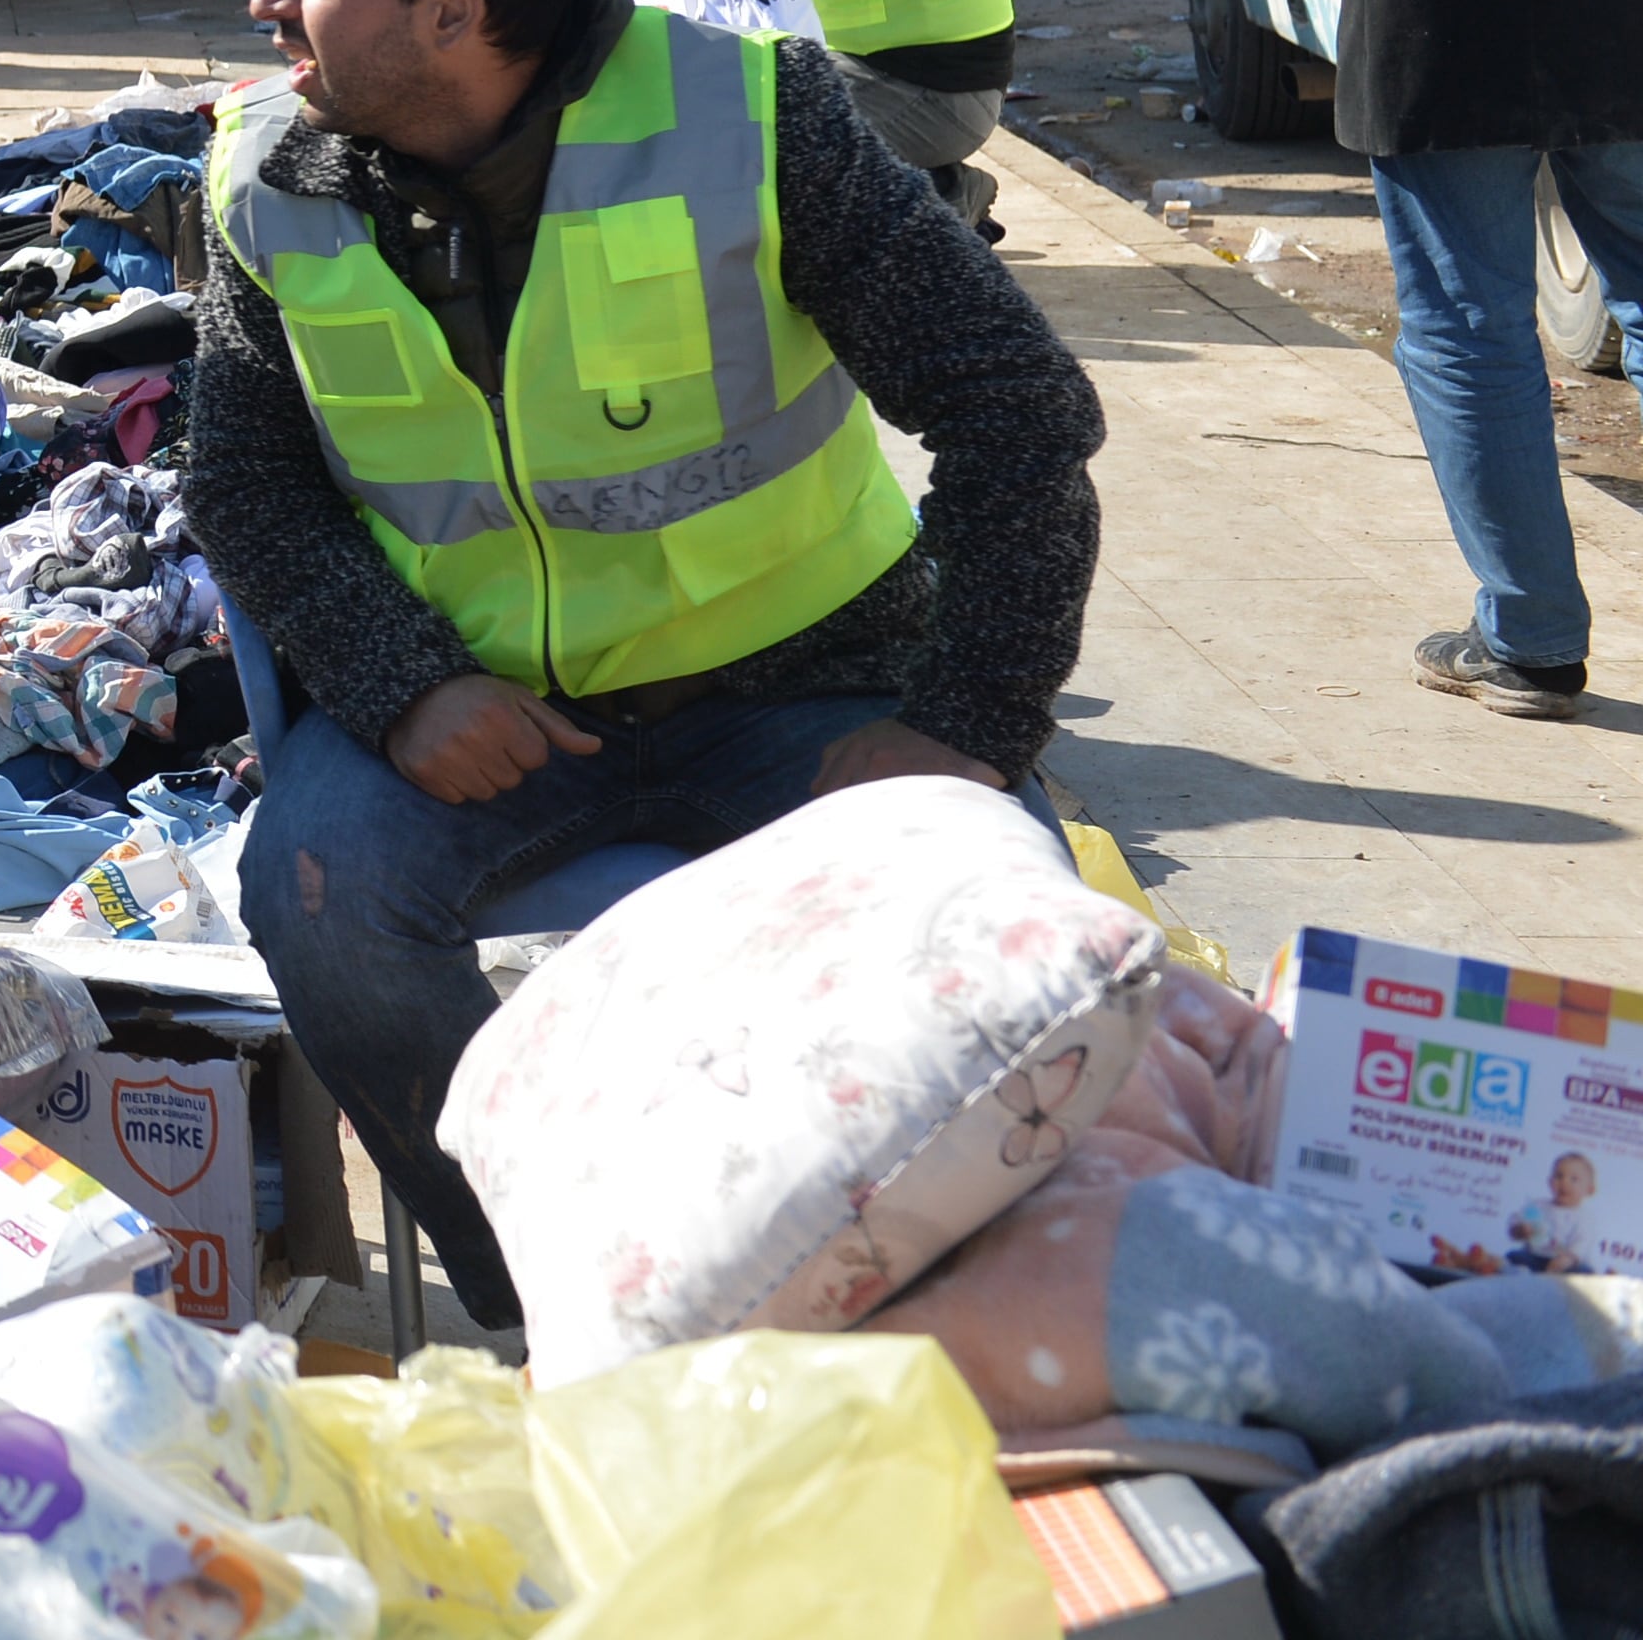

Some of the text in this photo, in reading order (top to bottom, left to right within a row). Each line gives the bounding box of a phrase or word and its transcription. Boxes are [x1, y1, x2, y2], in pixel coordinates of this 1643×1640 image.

[1359, 1049, 1523, 1114] eda
[1567, 1078, 1622, 1109] BPA
[125, 1120, 205, 1151] MASKE
[1349, 1122, 1511, 1168] KULPLU BİBERON
[1351, 1104, 1528, 1155] POLİPROPİLEN (PP)
[1599, 1239, 1636, 1261] 150
